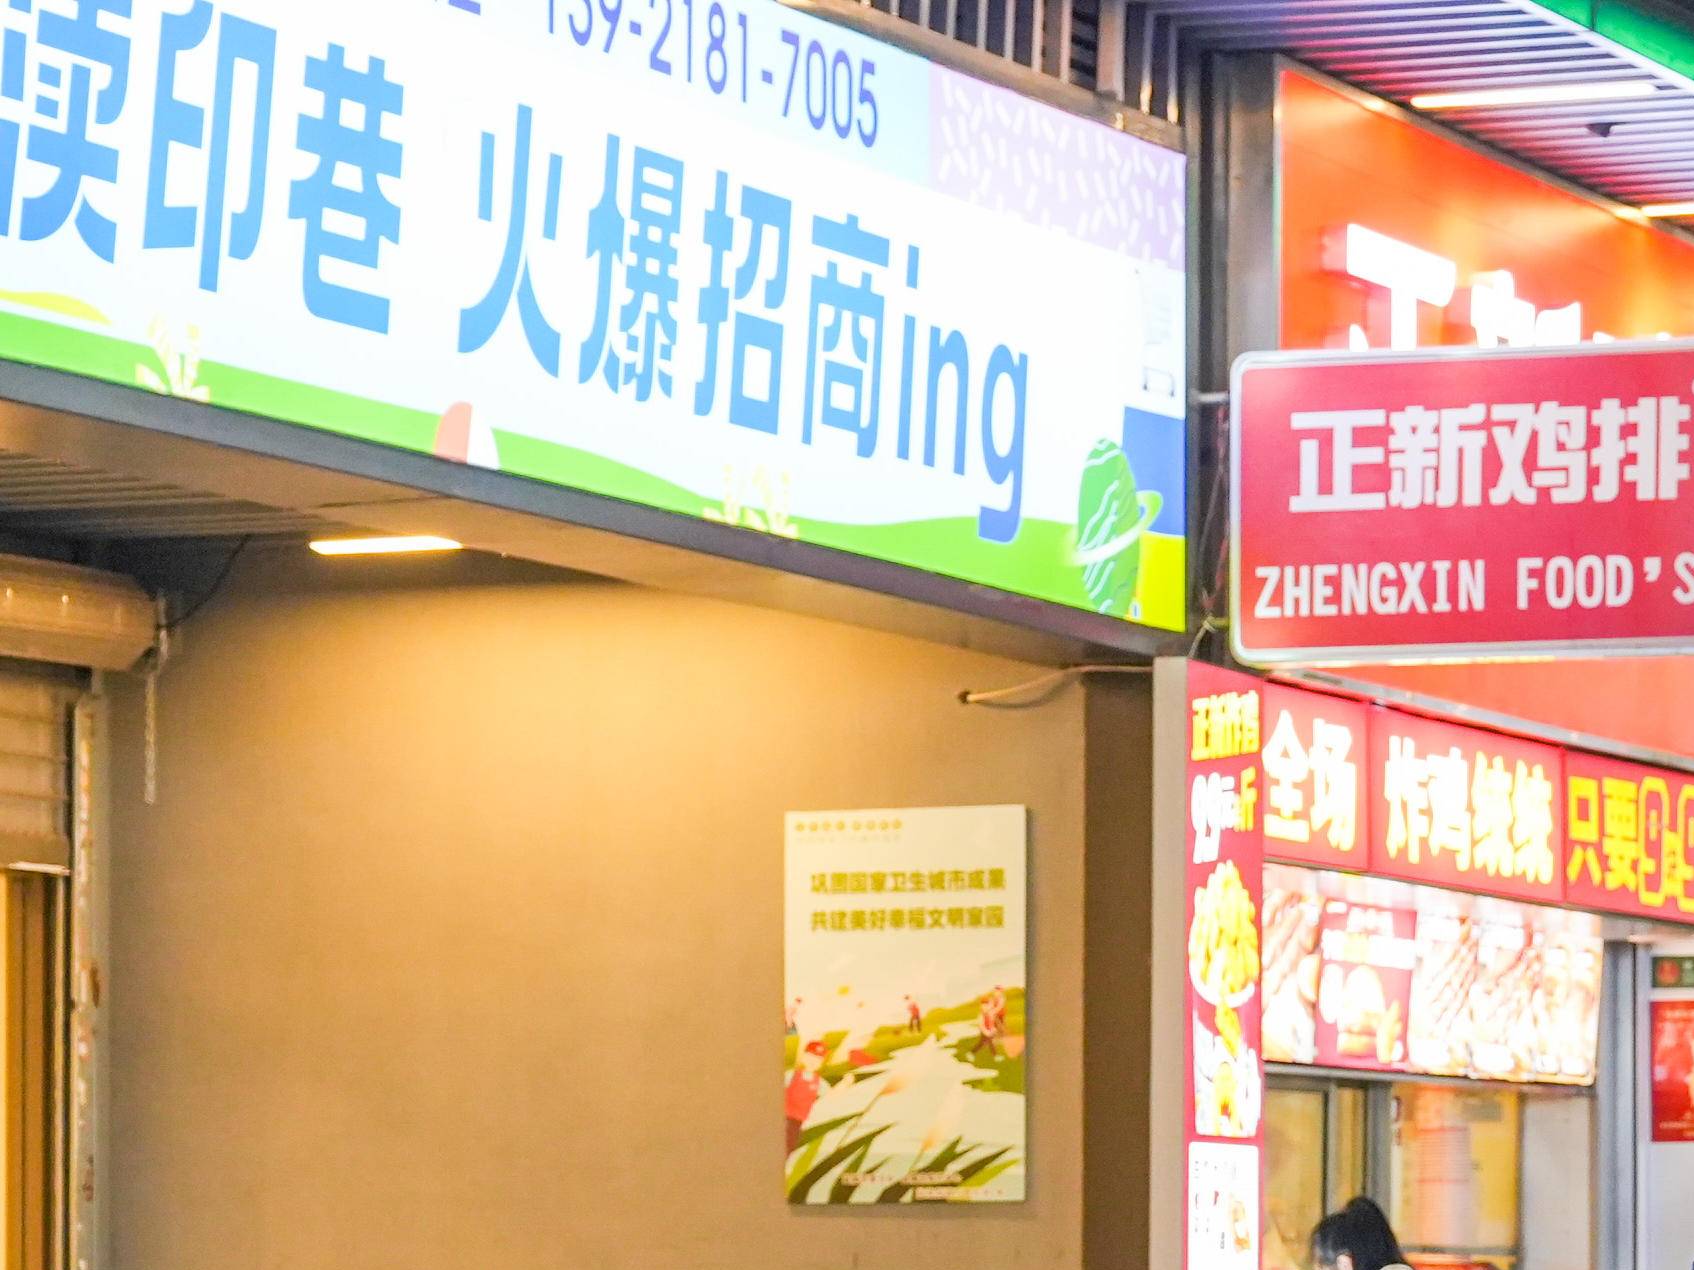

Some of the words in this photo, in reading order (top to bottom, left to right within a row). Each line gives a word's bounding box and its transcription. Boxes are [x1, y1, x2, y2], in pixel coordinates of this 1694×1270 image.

[459, 104, 1029, 544] 火爆招商ing
[1289, 397, 1691, 514] 正新鸡排
[1255, 559, 1486, 620] ZHENGXIN
